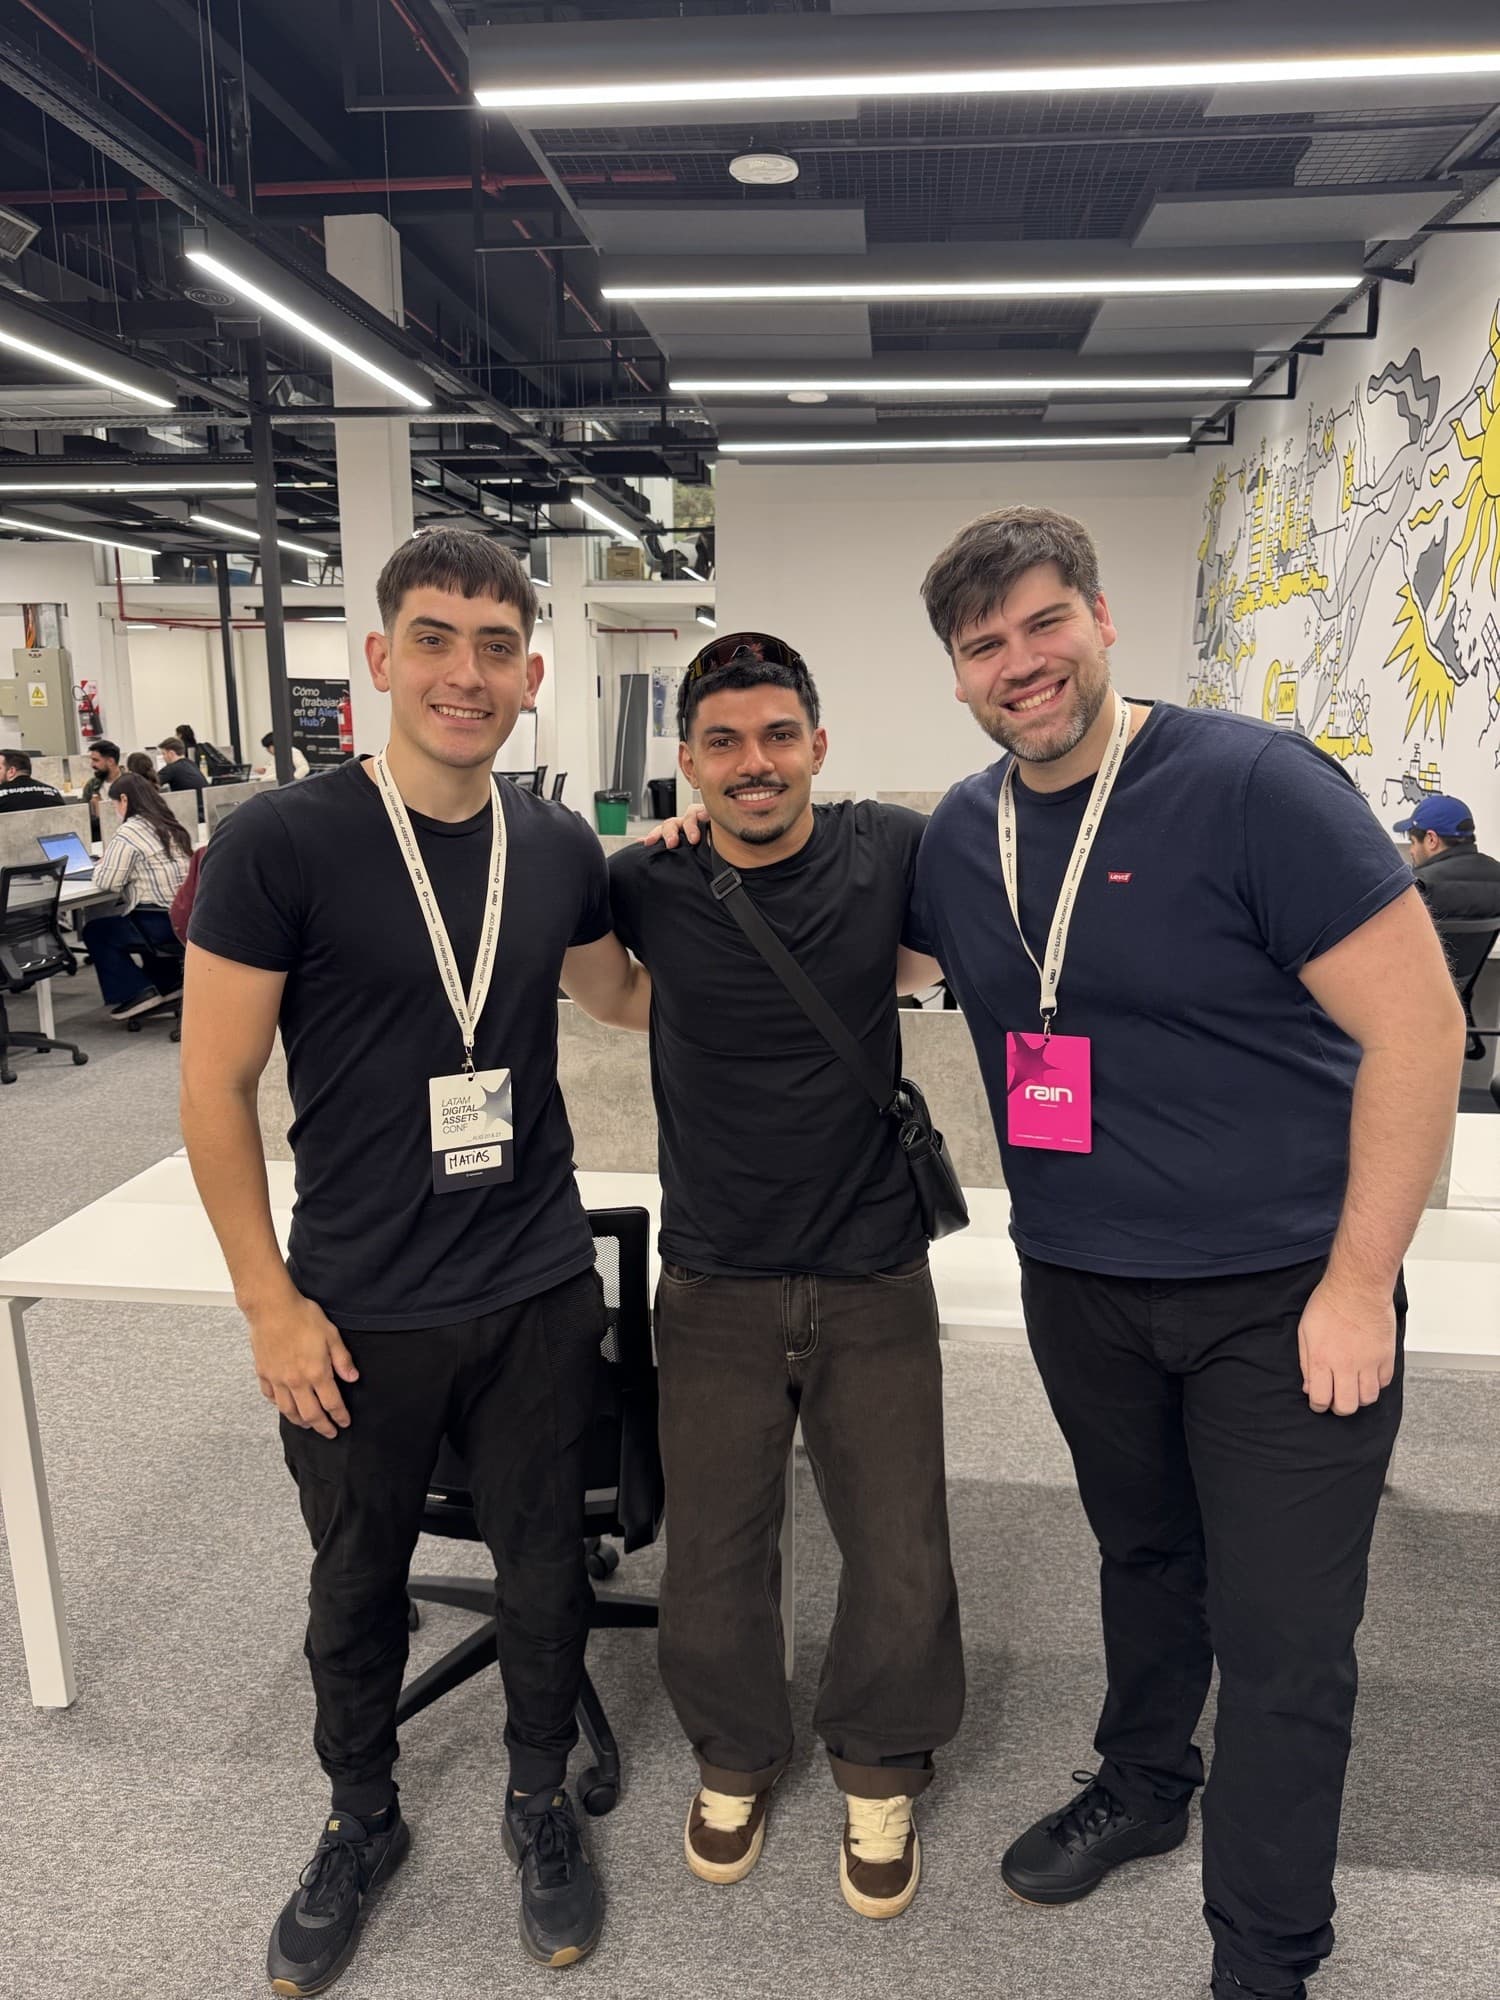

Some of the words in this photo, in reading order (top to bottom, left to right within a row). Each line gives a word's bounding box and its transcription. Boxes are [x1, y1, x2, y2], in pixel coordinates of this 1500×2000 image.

[292, 686, 320, 697] Cómo
[293, 709, 306, 717] en
[307, 708, 316, 717] el
[318, 708, 339, 719] Alep
[299, 718, 326, 727] Hub?
[1105, 760, 1115, 780] DIGITAL
[1097, 781, 1107, 802] ASSETS
[440, 946, 450, 966] DIGITAL
[446, 968, 455, 987] ASSETS
[1025, 1085, 1073, 1103] rain
[441, 1096, 471, 1107] LATAM
[442, 1104, 478, 1116] DIGITAL
[442, 1113, 479, 1125] ASSETS
[442, 1123, 469, 1134] CONF
